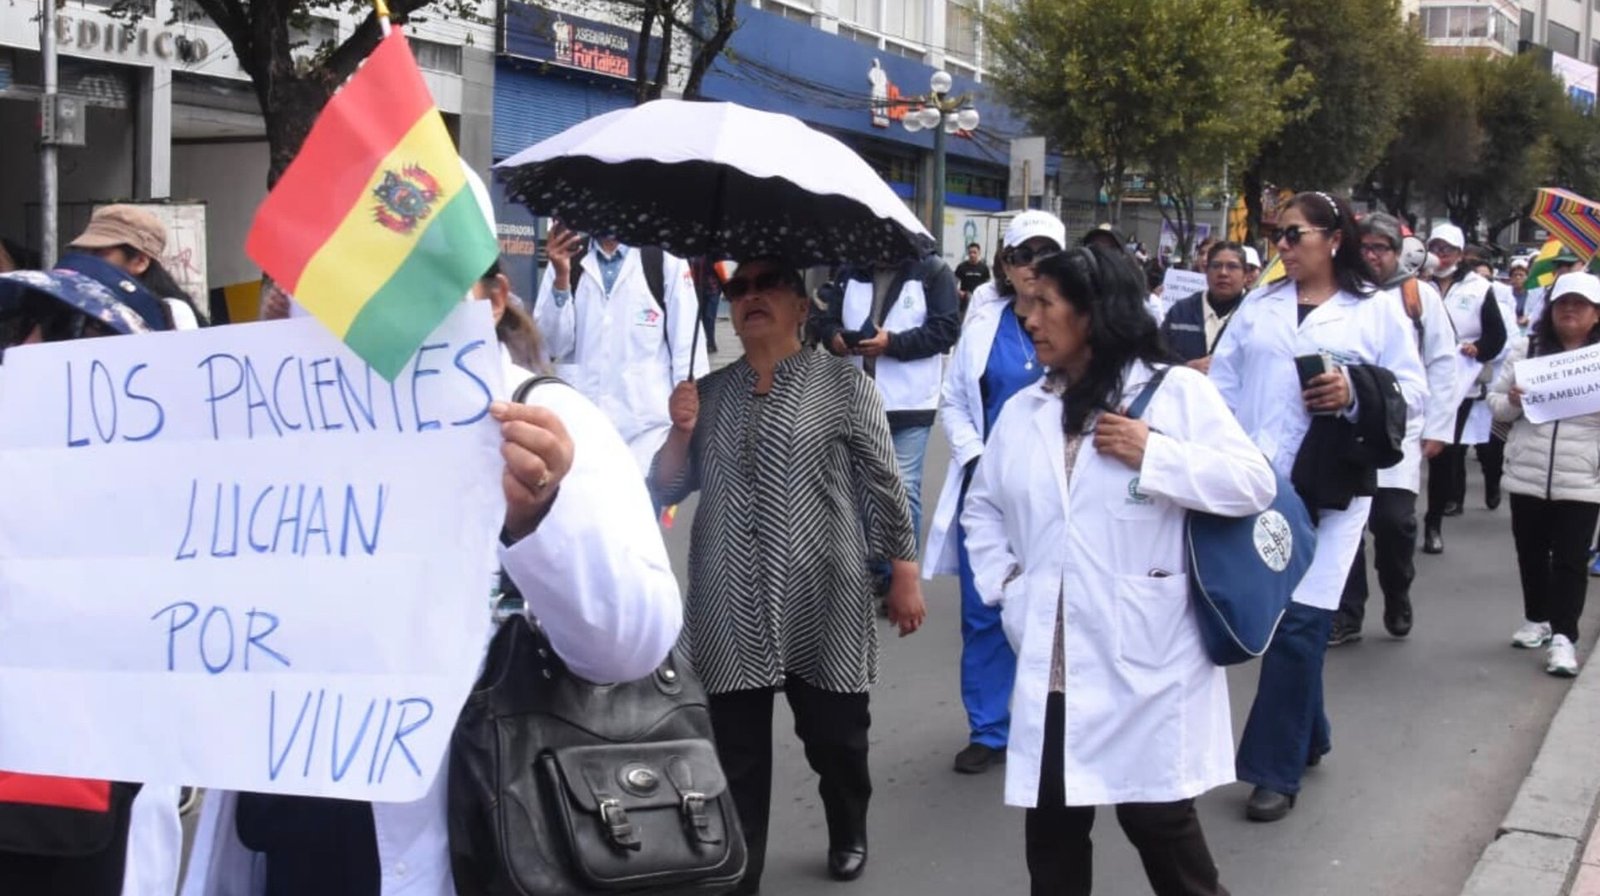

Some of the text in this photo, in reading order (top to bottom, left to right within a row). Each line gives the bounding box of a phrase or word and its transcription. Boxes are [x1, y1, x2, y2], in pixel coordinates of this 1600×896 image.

[574, 42, 629, 77] Fortaleza
[66, 359, 165, 447] LOS
[175, 478, 385, 561] LUCHAN
[151, 600, 292, 675] POR
[268, 688, 435, 786] VIVIR
